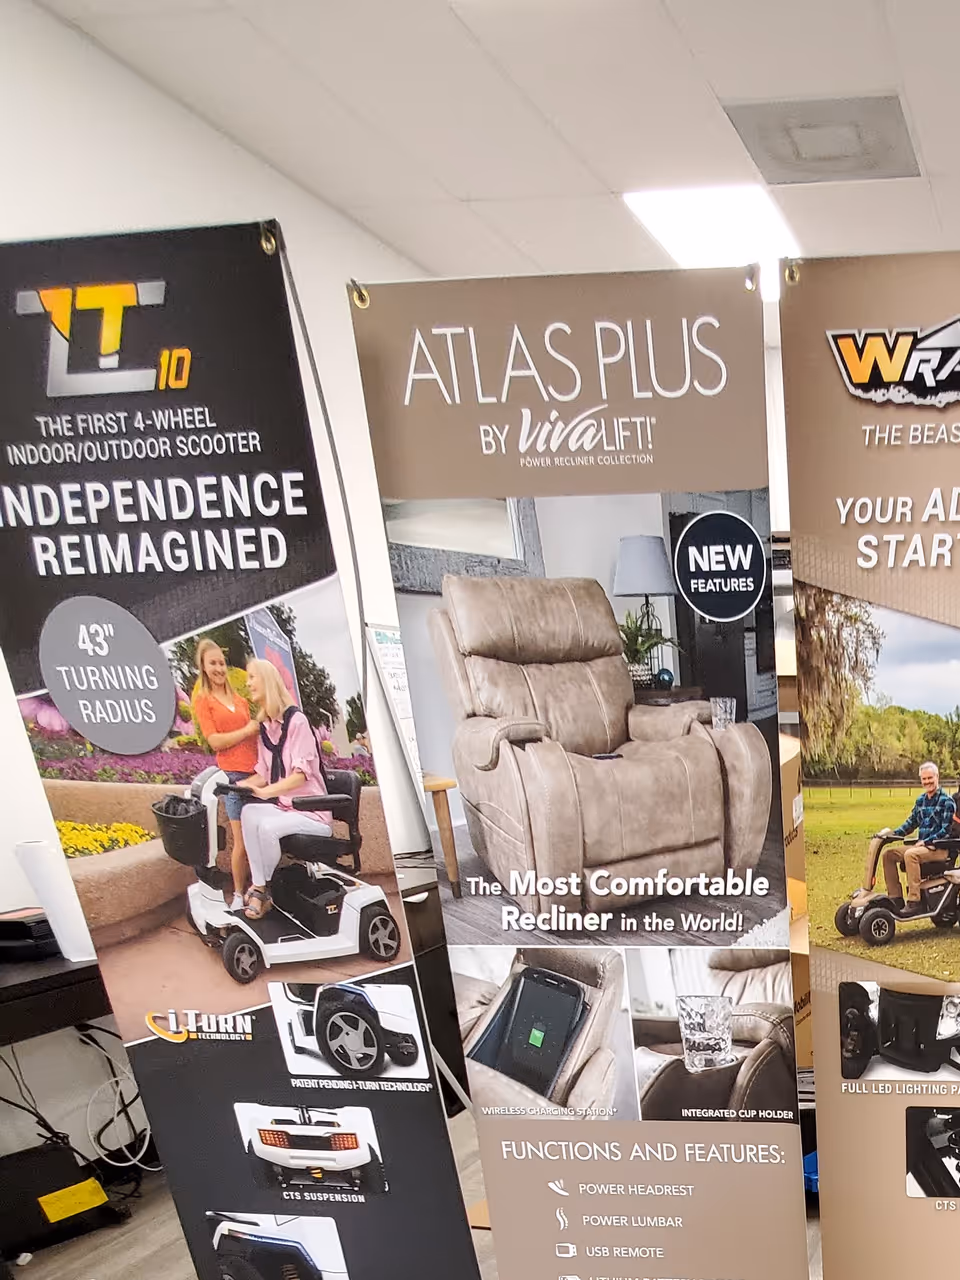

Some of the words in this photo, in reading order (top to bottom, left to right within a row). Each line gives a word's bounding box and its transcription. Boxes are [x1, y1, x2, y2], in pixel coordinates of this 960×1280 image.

[404, 322, 582, 406] ATLAS
[594, 315, 728, 401] PLUS
[35, 414, 74, 437] THE
[76, 411, 129, 435] FIRST
[133, 407, 217, 431] 4-WHEEL
[479, 423, 510, 455] BY
[861, 424, 902, 446] THE
[7, 437, 171, 466] INDOOR/OUTDOOR
[176, 432, 262, 454] SCOOTER
[520, 456, 552, 468] POWER
[554, 455, 595, 468] RECLINER
[597, 454, 654, 467] COLLECTION
[0, 472, 308, 528] NDEPENDENCE
[836, 497, 913, 525] YOUR
[32, 526, 288, 577] REIMAGINED
[688, 544, 753, 572] NEW
[690, 577, 755, 594] FEATURES
[56, 665, 159, 691] TURNING
[78, 699, 156, 724] RADIUS
[466, 877, 502, 896] The
[509, 870, 581, 897] Most
[589, 869, 770, 897] Comfortable
[501, 905, 613, 932] Recliner
[620, 912, 638, 932] in
[643, 912, 675, 932] the
[680, 912, 744, 933] World!
[197, 1032, 246, 1041] TECHNOLOGY
[291, 1078, 319, 1088] PATENT
[320, 1079, 353, 1089] PENDING
[841, 1082, 869, 1094] FULL
[872, 1083, 892, 1095] LED
[895, 1083, 948, 1096] LIGHTING
[481, 1106, 525, 1116] WIRELESS
[527, 1107, 575, 1116] CHARGING
[681, 1108, 737, 1119] INTEGRATED
[738, 1109, 757, 1119] CUP
[758, 1109, 794, 1120] HOLDER
[501, 1140, 622, 1162] FUNCTIONS
[629, 1142, 677, 1162] AND
[684, 1143, 786, 1164] FEATURES:
[283, 1191, 301, 1201] CTS
[304, 1193, 365, 1203] SUSPENSION
[579, 1183, 625, 1196] POWER
[628, 1184, 694, 1197] HEADREST
[936, 1200, 957, 1212] CTS
[583, 1215, 628, 1227] POWER
[631, 1216, 683, 1228] LUMBAR
[585, 1246, 610, 1258] USB
[613, 1247, 664, 1259] REMOTE
